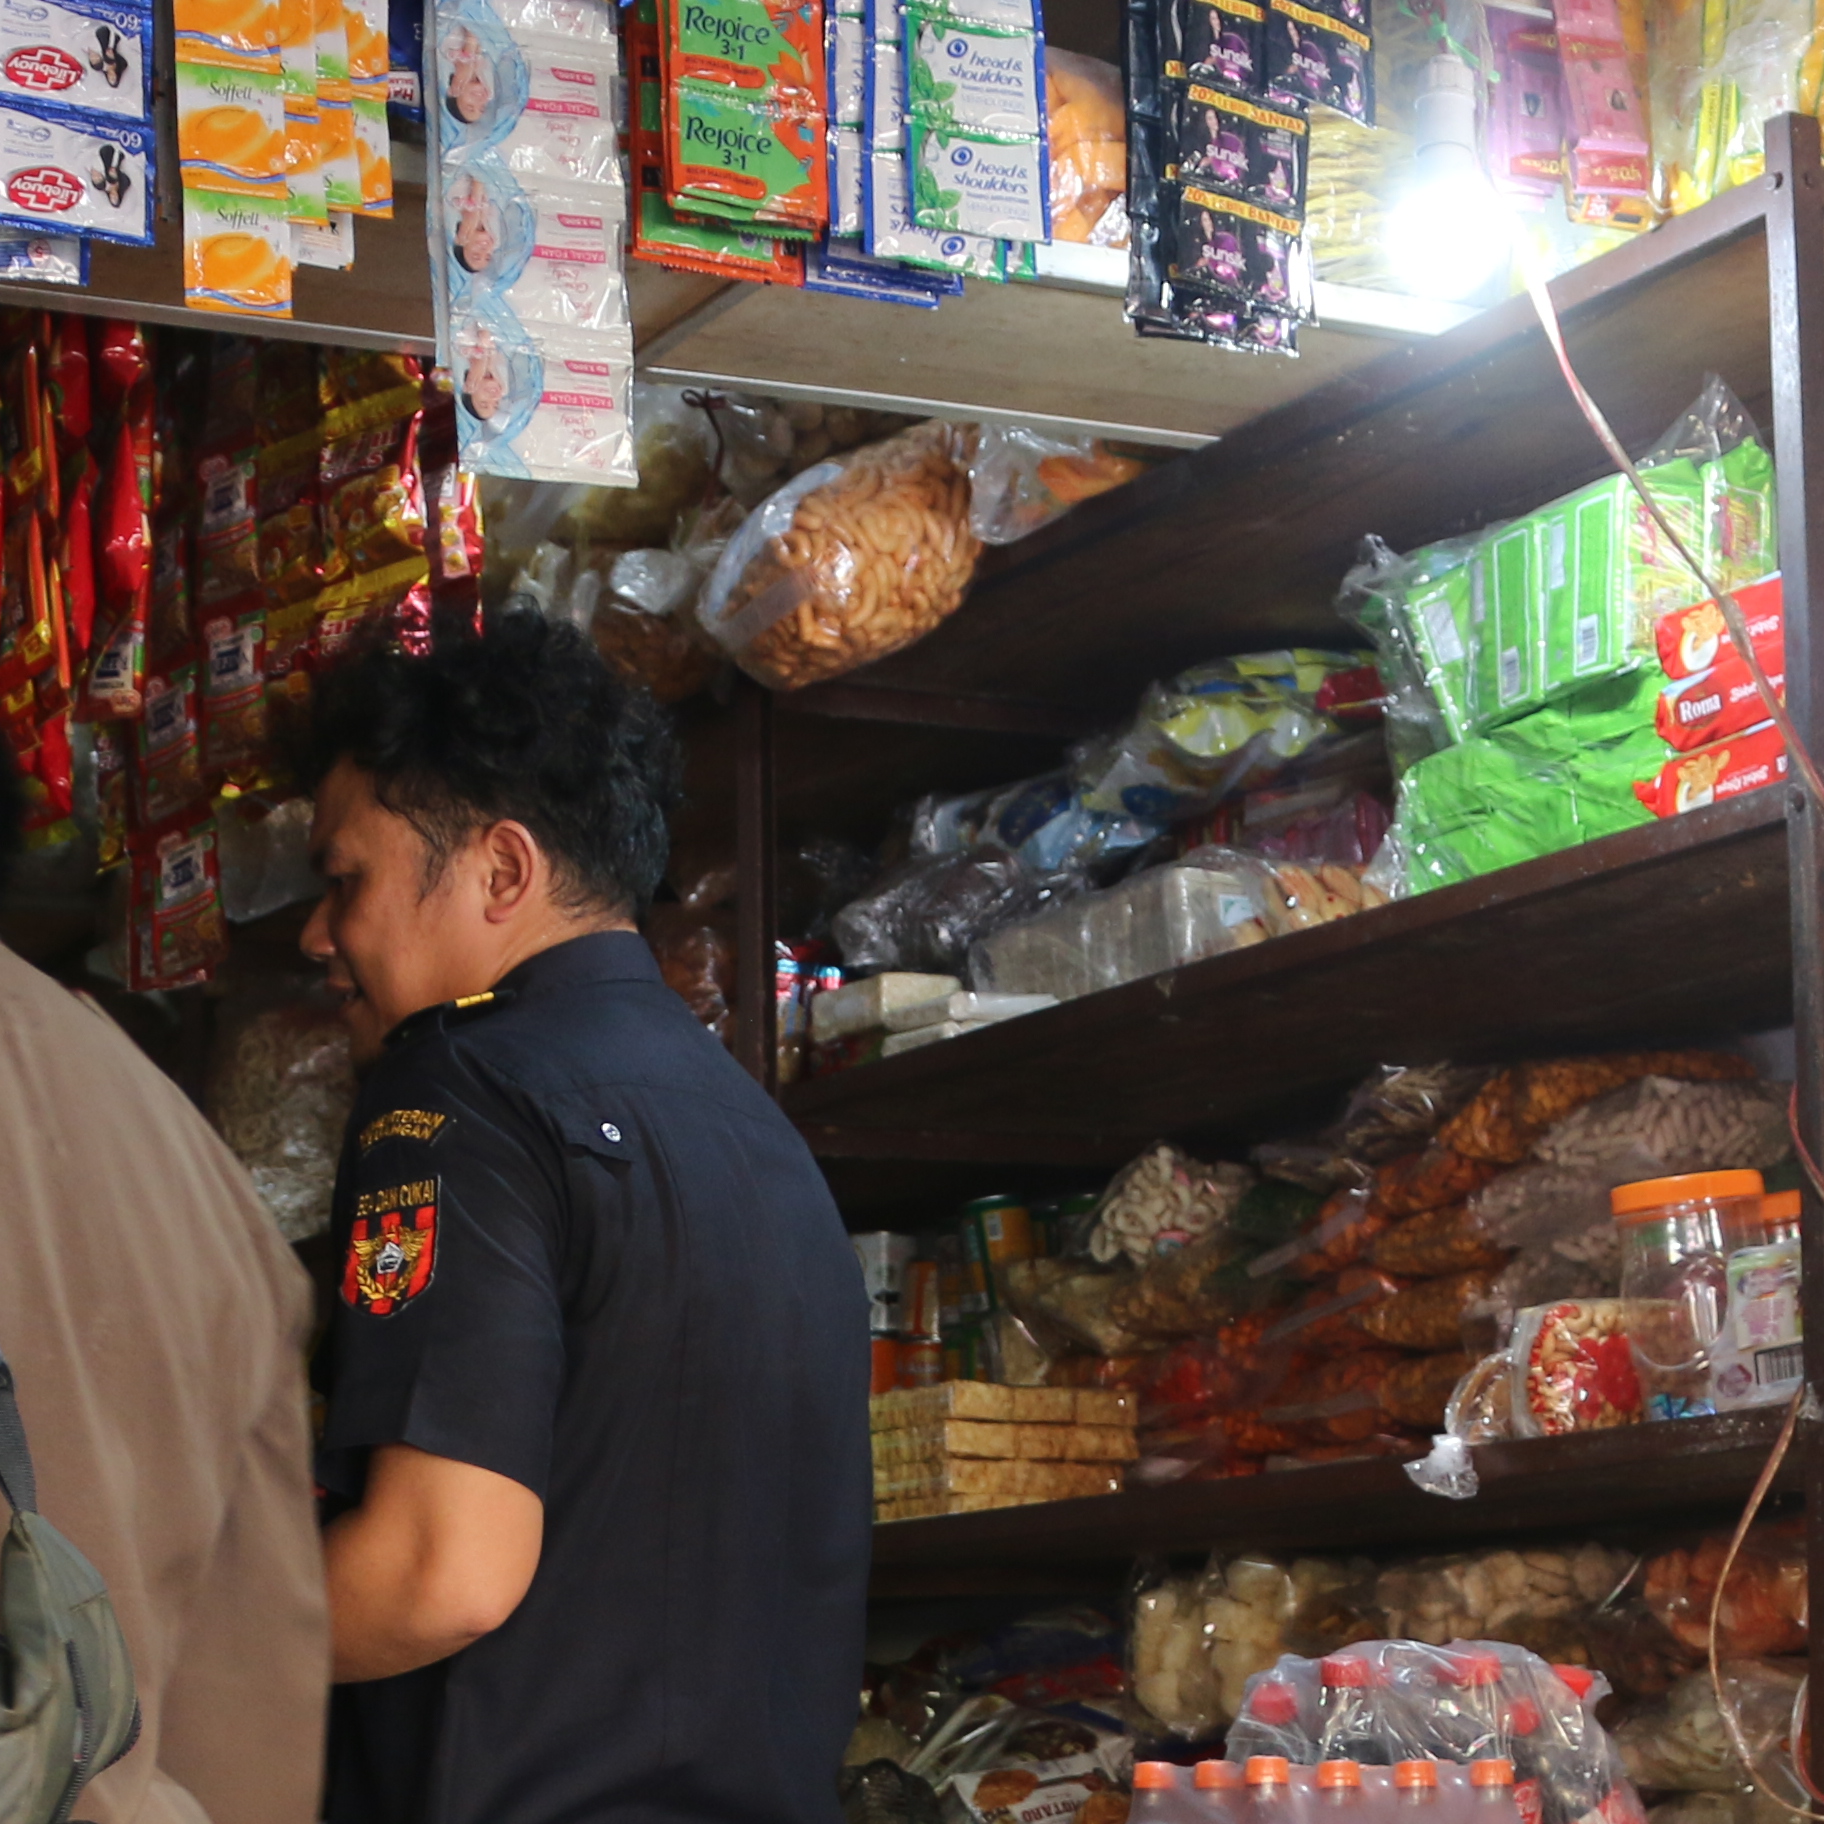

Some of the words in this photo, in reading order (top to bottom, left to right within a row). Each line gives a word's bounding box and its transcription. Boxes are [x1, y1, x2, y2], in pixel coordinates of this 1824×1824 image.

[686, 8, 770, 46] Rejoice
[8, 57, 80, 82] Lifebuoy
[948, 67, 1023, 88] shoulders
[535, 101, 563, 112] FOAM
[567, 102, 597, 114] FACIAL
[119, 130, 143, 148] 60
[686, 118, 771, 155] Rejoice
[12, 179, 81, 203] Lifebuoy
[953, 174, 1029, 195] shoulders
[537, 248, 567, 258] FOAM
[571, 249, 603, 261] FACIAL
[549, 393, 578, 404] FOAM
[580, 395, 611, 407] FACIAL
[1679, 695, 1722, 724] Roma
